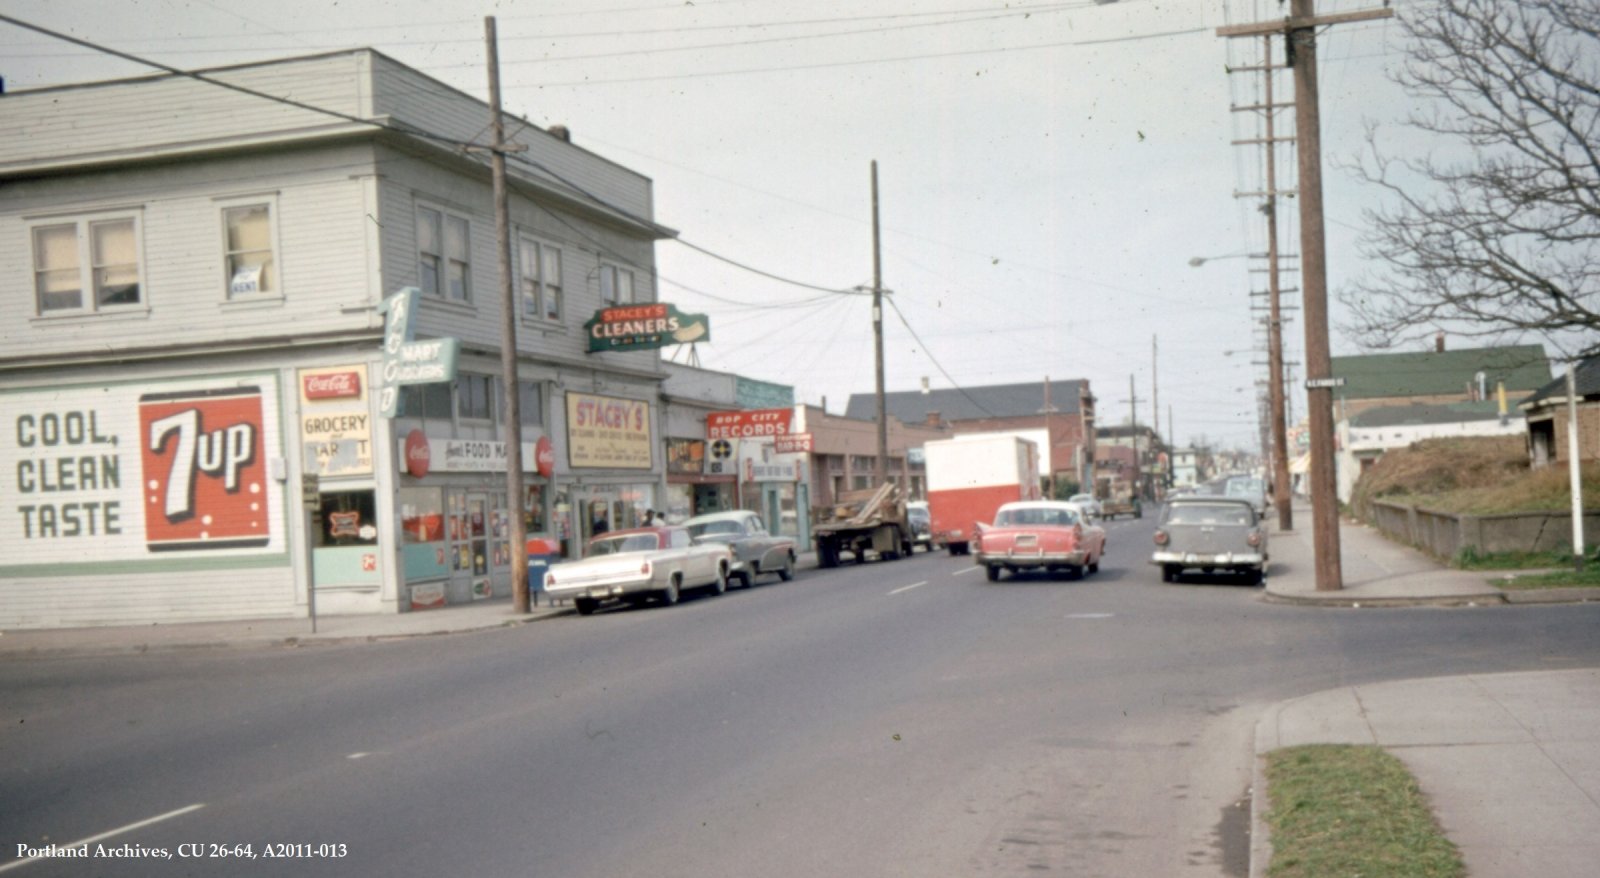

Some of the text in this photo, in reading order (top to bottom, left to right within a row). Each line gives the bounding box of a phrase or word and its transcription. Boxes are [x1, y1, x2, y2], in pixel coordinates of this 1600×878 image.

[602, 304, 666, 321] STACEY'S
[592, 317, 680, 338] CLEANERS
[402, 342, 442, 359] MART
[305, 415, 367, 434] GROCERY
[576, 400, 643, 431] STACEY'S
[751, 413, 781, 421] CITY
[17, 410, 118, 447] COOL,
[710, 423, 785, 438] RECORDS
[465, 442, 491, 458] FOOD
[17, 455, 120, 493] CLEAN
[18, 501, 121, 539] TASTE
